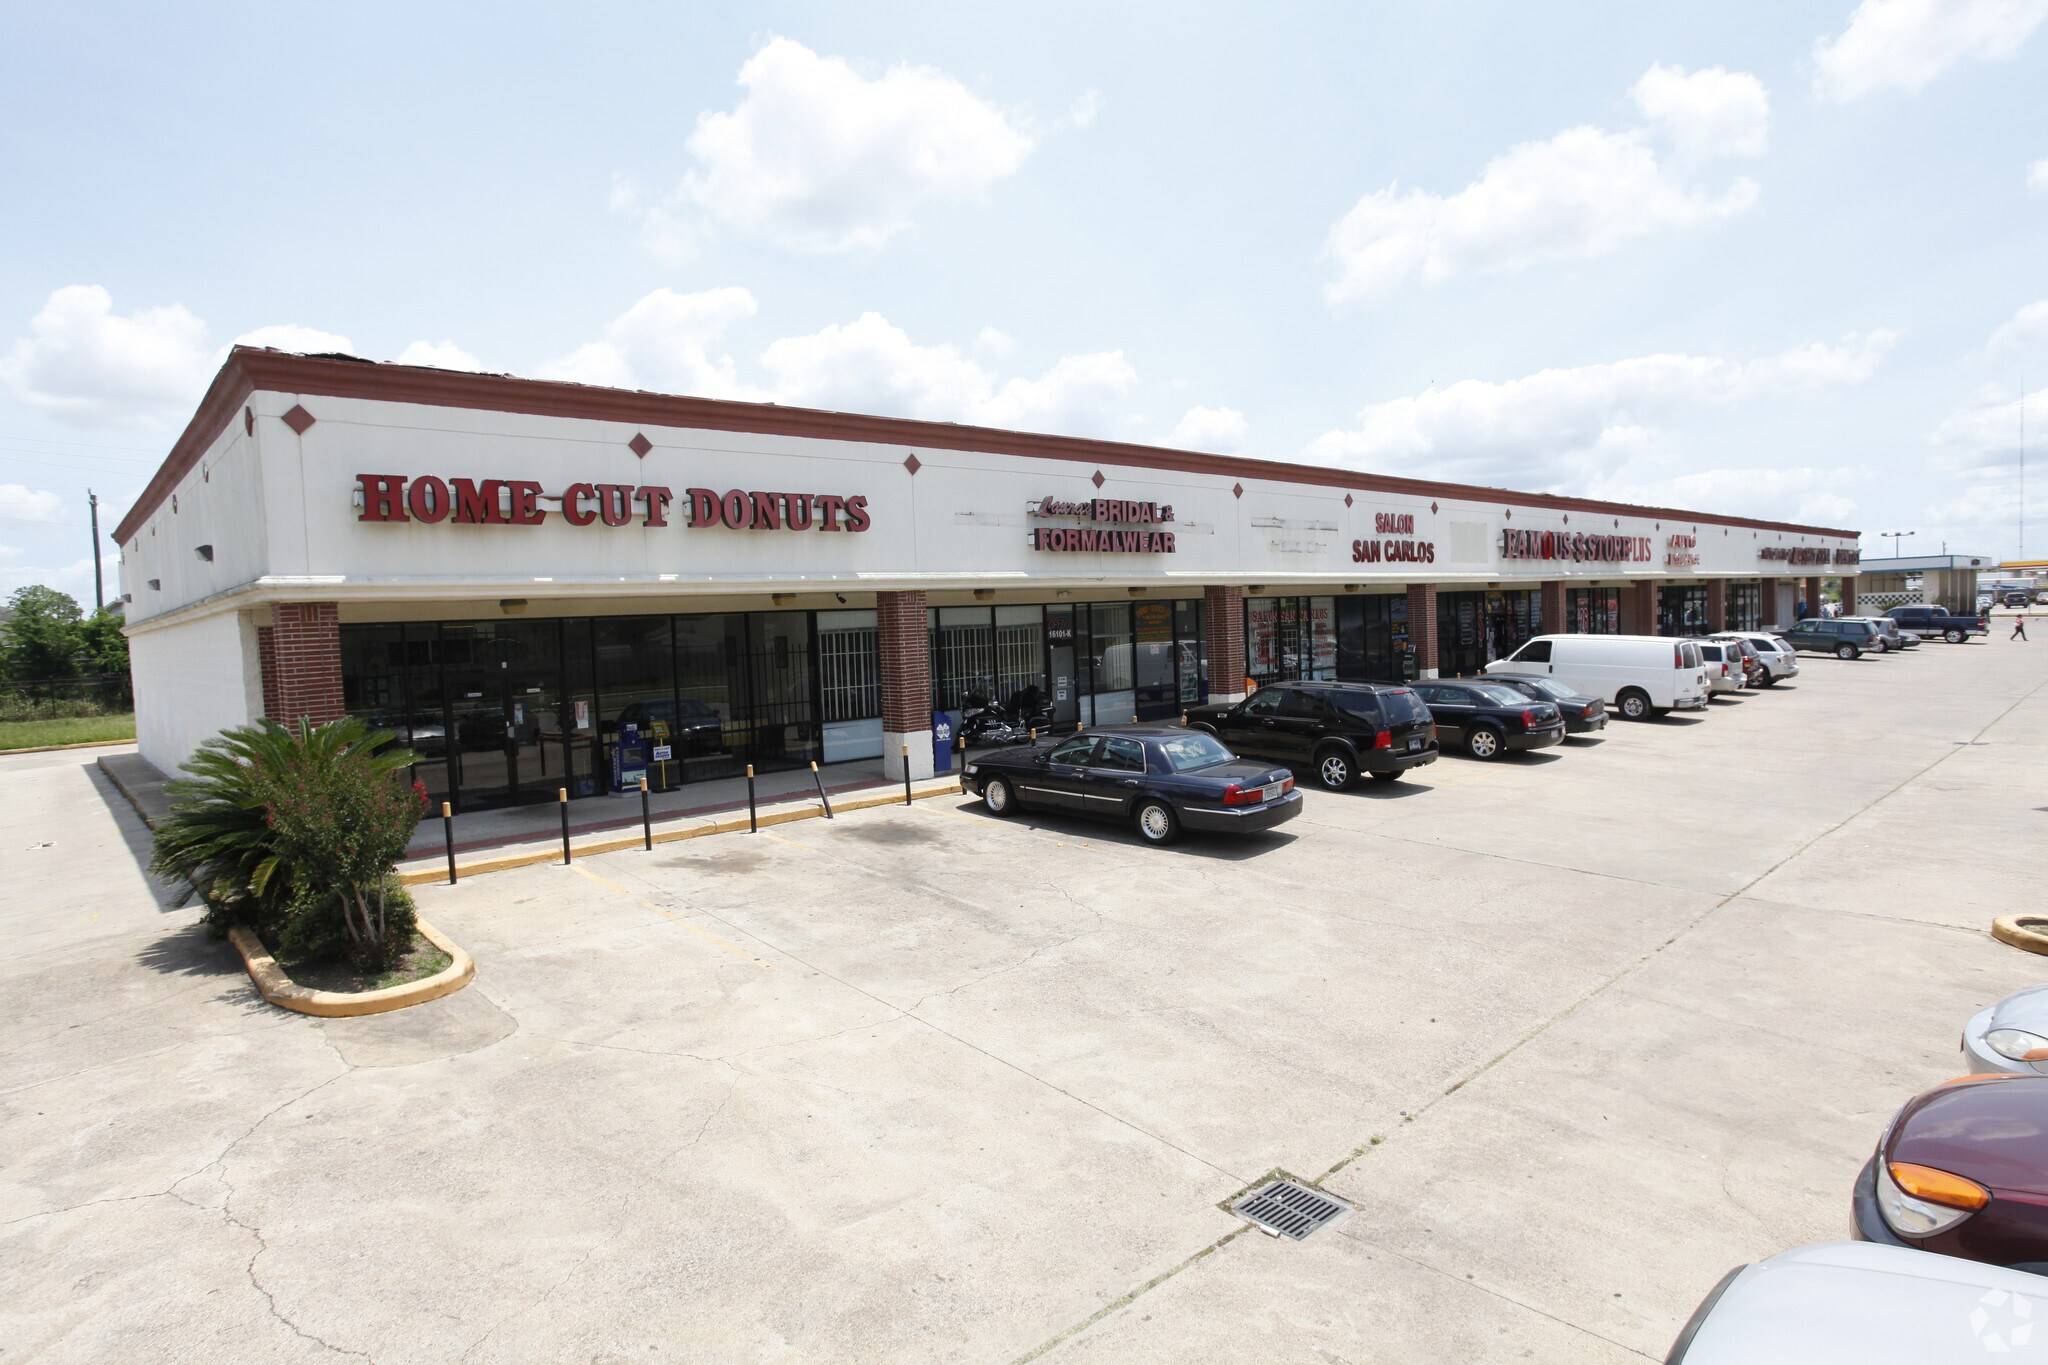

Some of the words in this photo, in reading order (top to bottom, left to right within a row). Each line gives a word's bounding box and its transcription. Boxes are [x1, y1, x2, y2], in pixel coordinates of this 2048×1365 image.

[356, 474, 547, 525] HOME
[562, 482, 673, 527] CUT
[686, 488, 871, 532] DONUTS
[1091, 498, 1163, 523] BRIDAL
[1162, 505, 1175, 522] &
[1375, 512, 1414, 534] SALON
[1034, 528, 1176, 553] FORMALWEAR
[1352, 540, 1381, 563] SAN
[1384, 540, 1434, 564] CARLOS
[1502, 528, 1572, 560] FAMOUS
[1585, 534, 1630, 561] STORE
[1628, 536, 1652, 562] PLUS
[1280, 609, 1296, 621] SAN
[1049, 629, 1072, 639] 16101-K
